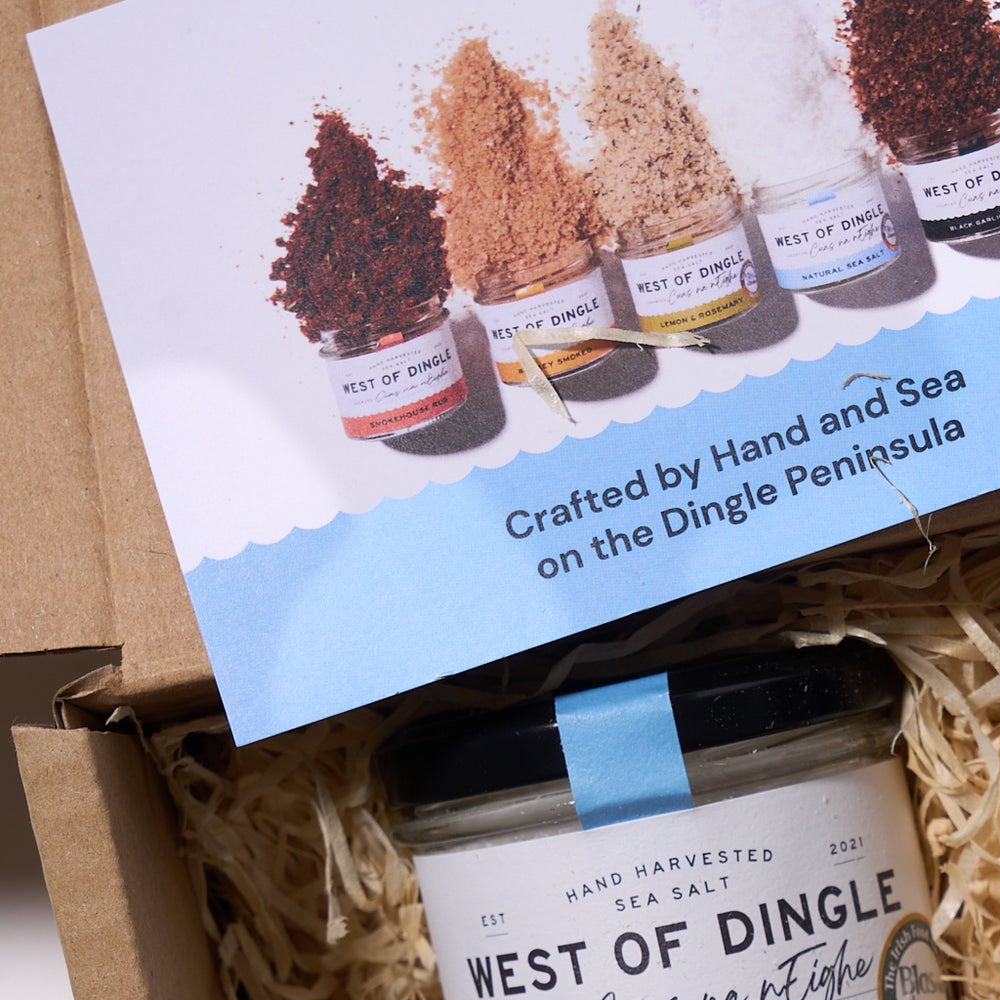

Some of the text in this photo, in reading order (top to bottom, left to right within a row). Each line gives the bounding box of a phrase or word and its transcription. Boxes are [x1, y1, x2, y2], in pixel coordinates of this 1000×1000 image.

[923, 182, 958, 198] WEST
[965, 175, 984, 190] OF
[775, 232, 809, 247] WEST
[815, 224, 834, 239] OF
[841, 203, 884, 231] DINGLE
[949, 221, 974, 231] BLACK
[636, 278, 668, 294] WEST
[674, 271, 692, 286] OF
[700, 250, 745, 278] DINGLE
[802, 249, 884, 280] NATURAL SEA SALT
[550, 297, 600, 326] DINGLE
[659, 316, 689, 328] LEMON
[698, 296, 744, 318] ROSEMARY
[341, 378, 376, 394] WEST
[381, 370, 401, 386] OF
[407, 348, 452, 377] DINGLE
[557, 346, 593, 366] SMOKED
[369, 406, 430, 428] SMOKEHOUSE
[505, 368, 968, 539] Crafted by Hand and Sea
[537, 416, 967, 580] on the Dingle Peninsula
[829, 836, 865, 856] 2021
[566, 848, 774, 904] HAND HARVESTED
[614, 876, 733, 913] SEA SALT
[466, 868, 903, 1000] WEST OF DINGLE
[481, 912, 507, 927] EST
[898, 964, 937, 997] Blas
